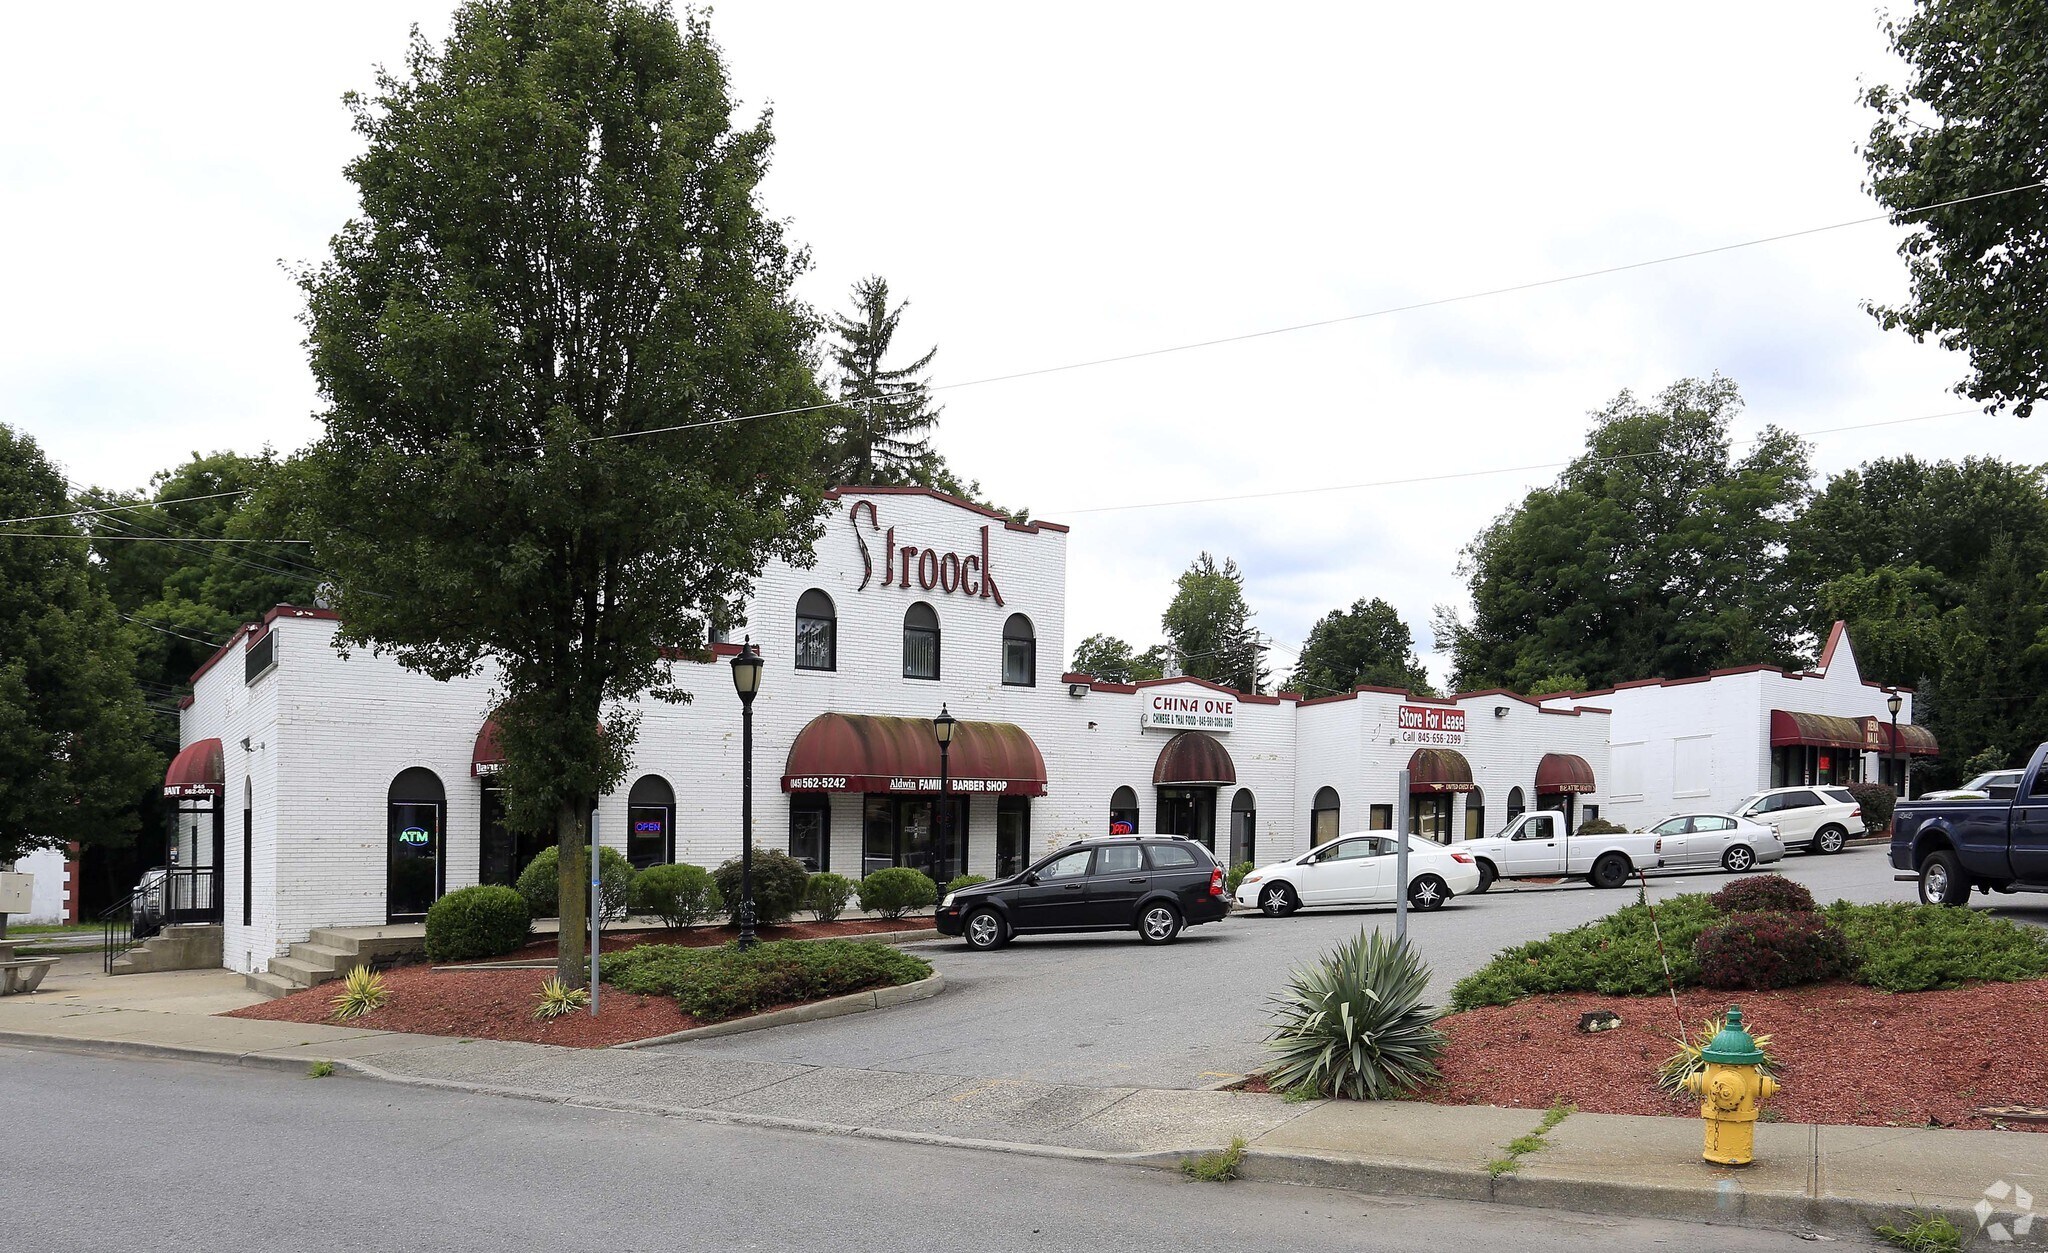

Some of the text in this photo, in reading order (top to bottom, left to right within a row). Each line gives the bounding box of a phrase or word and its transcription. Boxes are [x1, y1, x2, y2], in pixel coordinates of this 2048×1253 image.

[850, 500, 1005, 607] Stroock
[1153, 697, 1233, 714] CHINA ONE
[1153, 713, 1170, 724] CHINESE
[1175, 714, 1185, 726] THAI
[1185, 715, 1197, 726] FOOD
[1400, 707, 1464, 731] Store For Lease
[1402, 731, 1462, 745] Call 845-656-2399
[890, 778, 916, 790] Aldwin
[918, 779, 949, 791] FAMIL
[952, 780, 985, 791] BARBER
[986, 781, 1008, 792] SHOP
[636, 823, 660, 831] OPEN
[399, 831, 429, 842] ATM
